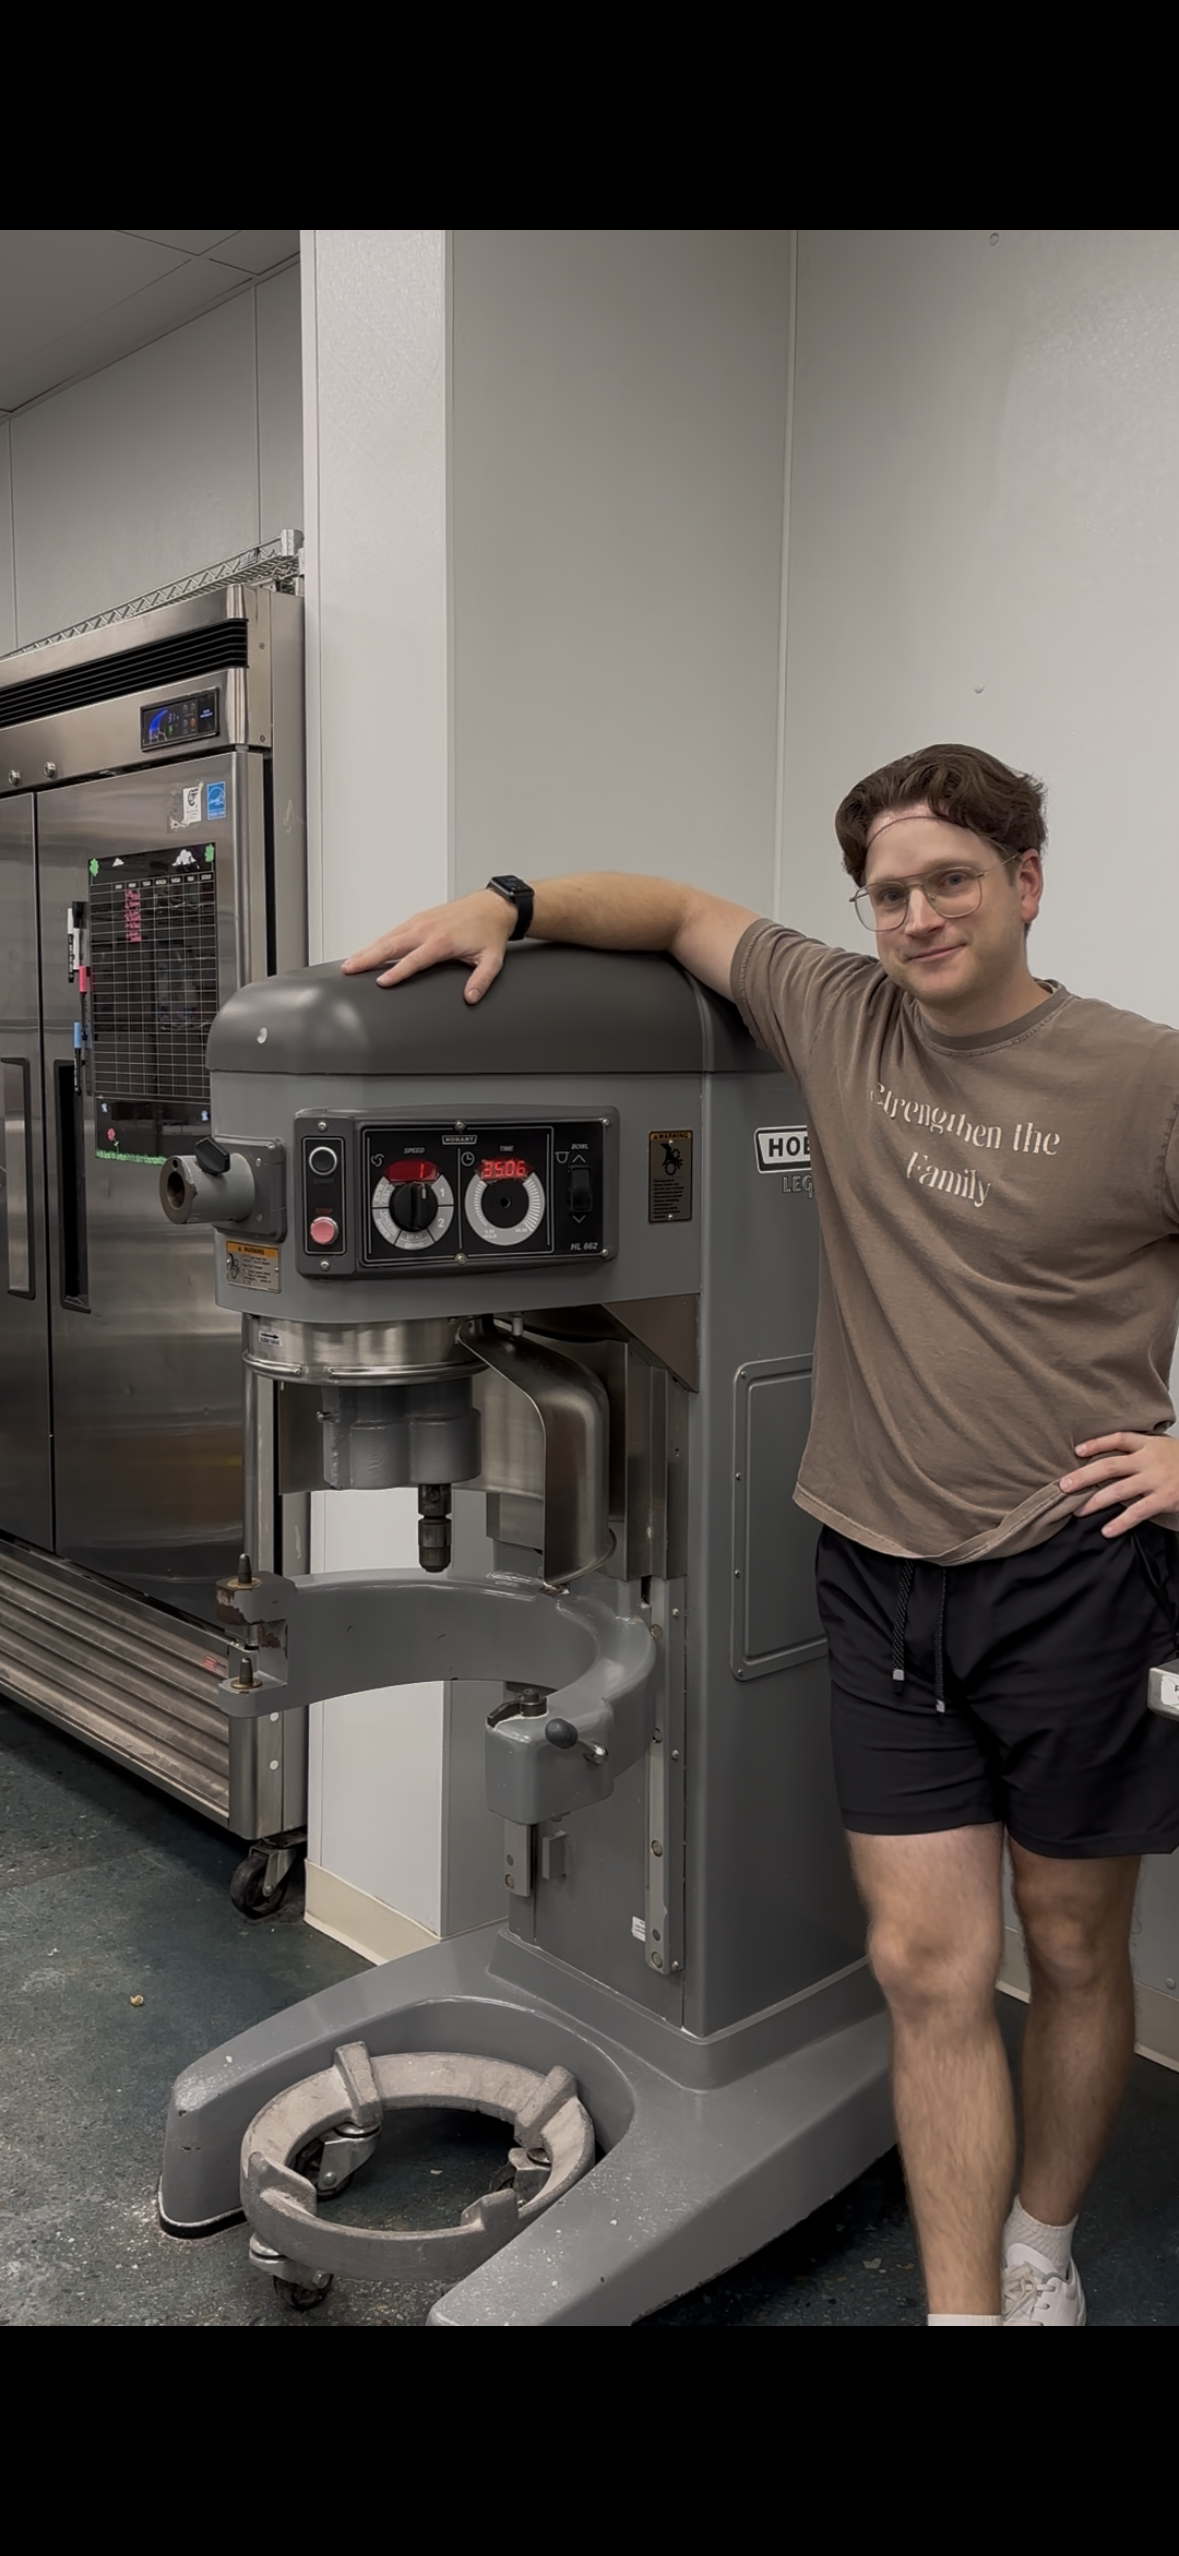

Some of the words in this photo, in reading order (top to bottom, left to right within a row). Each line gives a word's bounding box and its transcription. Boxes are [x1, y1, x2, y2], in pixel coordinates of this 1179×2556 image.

[870, 1083, 1002, 1149] Strengthen
[1013, 1122, 1060, 1156] the
[420, 1162, 425, 1179] 1
[906, 1152, 991, 1208] Family
[439, 1188, 445, 1197] 1
[438, 1218, 445, 1228] 2
[583, 1242, 599, 1250] 662
